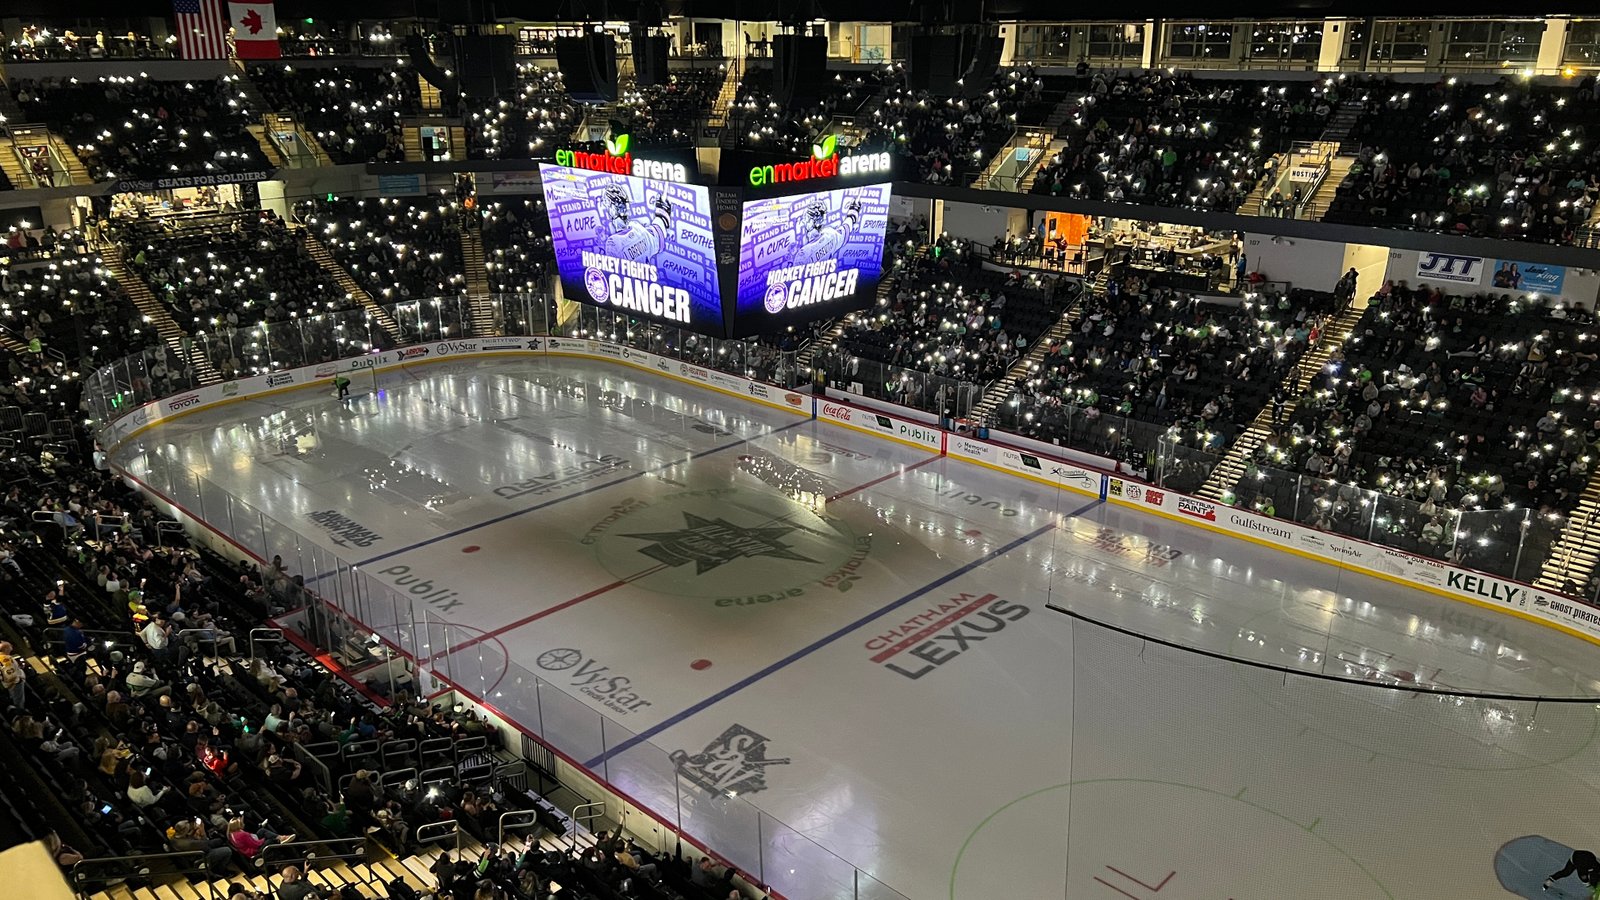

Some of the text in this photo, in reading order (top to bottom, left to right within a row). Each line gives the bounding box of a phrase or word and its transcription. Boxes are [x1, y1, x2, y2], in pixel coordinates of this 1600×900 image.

[556, 148, 686, 183] enmarket arena
[750, 151, 891, 186] enmarket arena
[158, 171, 267, 188] SEATS FOR SOLDIERS
[562, 202, 582, 212] STAND
[574, 216, 596, 230] CURE
[680, 211, 707, 226] STAND
[758, 228, 780, 242] STAND
[766, 236, 791, 254] CURE
[582, 250, 620, 273] HOCKEY
[620, 259, 658, 282] FIGHTS
[767, 258, 837, 286] HOCKEY FIGHTS
[787, 268, 859, 309] CANCER
[608, 274, 690, 323] CANCER
[448, 341, 477, 352] VyStar
[352, 356, 388, 368] Publix
[169, 398, 200, 411] TOYOTA
[900, 425, 936, 443] Publix
[964, 442, 988, 453] Memorial
[964, 448, 981, 456] Health
[1178, 497, 1215, 510] SPECTRUM
[1178, 502, 1208, 514] PAINT
[1230, 514, 1292, 540] Gulfstream
[1386, 550, 1445, 570] MAKING OUR MARK
[378, 565, 464, 613] Publix
[1447, 570, 1520, 604] KELLY
[714, 587, 804, 608] arena
[1550, 600, 1573, 615] GHOST
[864, 592, 976, 650] CHATHAM
[884, 600, 1031, 680] LEXUS
[570, 658, 652, 712] VyStar
